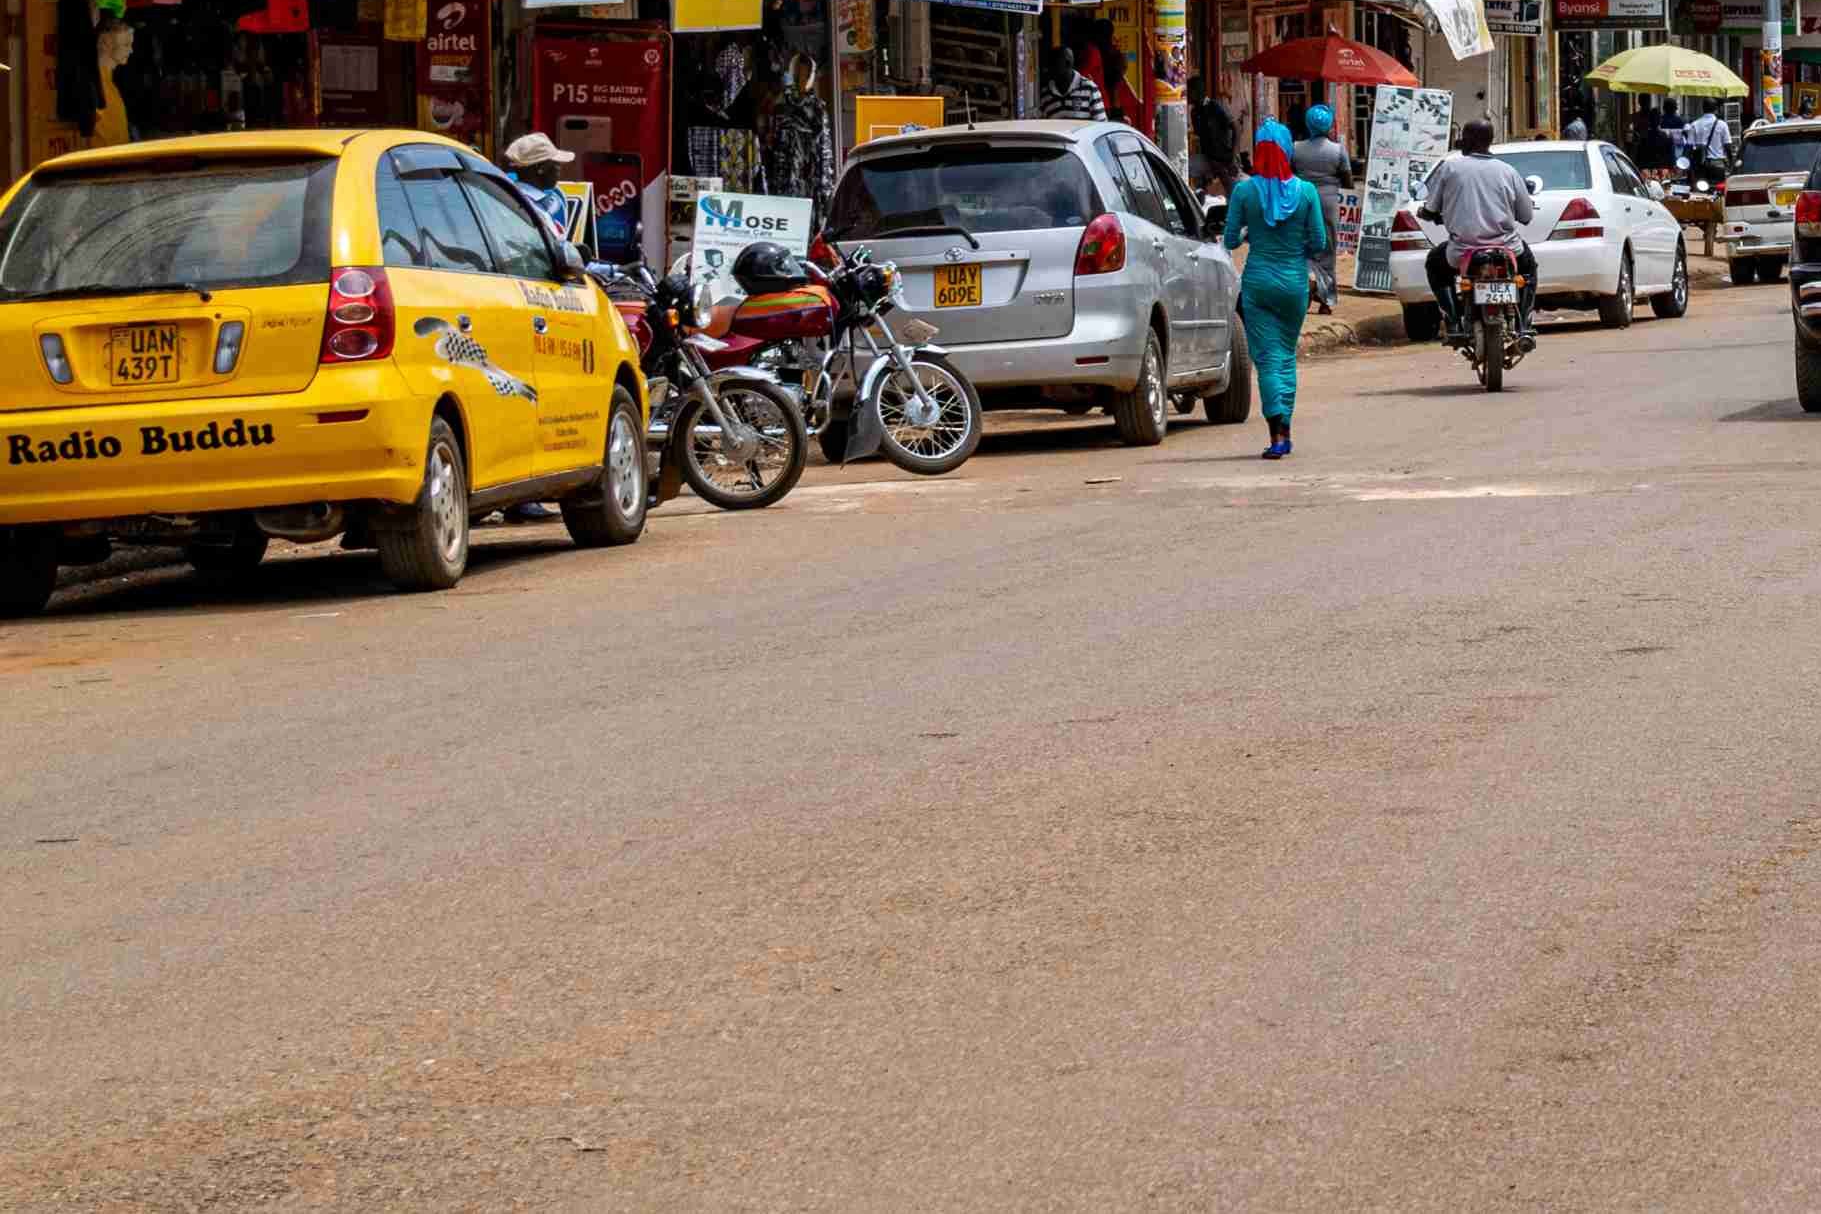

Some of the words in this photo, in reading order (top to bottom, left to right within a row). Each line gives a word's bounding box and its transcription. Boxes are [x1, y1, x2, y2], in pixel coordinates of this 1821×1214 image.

[426, 33, 479, 52] airtel
[552, 83, 589, 104] P15
[610, 85, 645, 96] BATTERY
[610, 95, 649, 106] MEMORY
[699, 194, 789, 231] MOSE
[947, 266, 977, 285] UAY
[937, 286, 977, 304] 609E
[131, 329, 175, 354] UAN
[117, 356, 172, 381] 439T
[8, 430, 122, 465] Radio
[140, 418, 275, 456] Buddu
